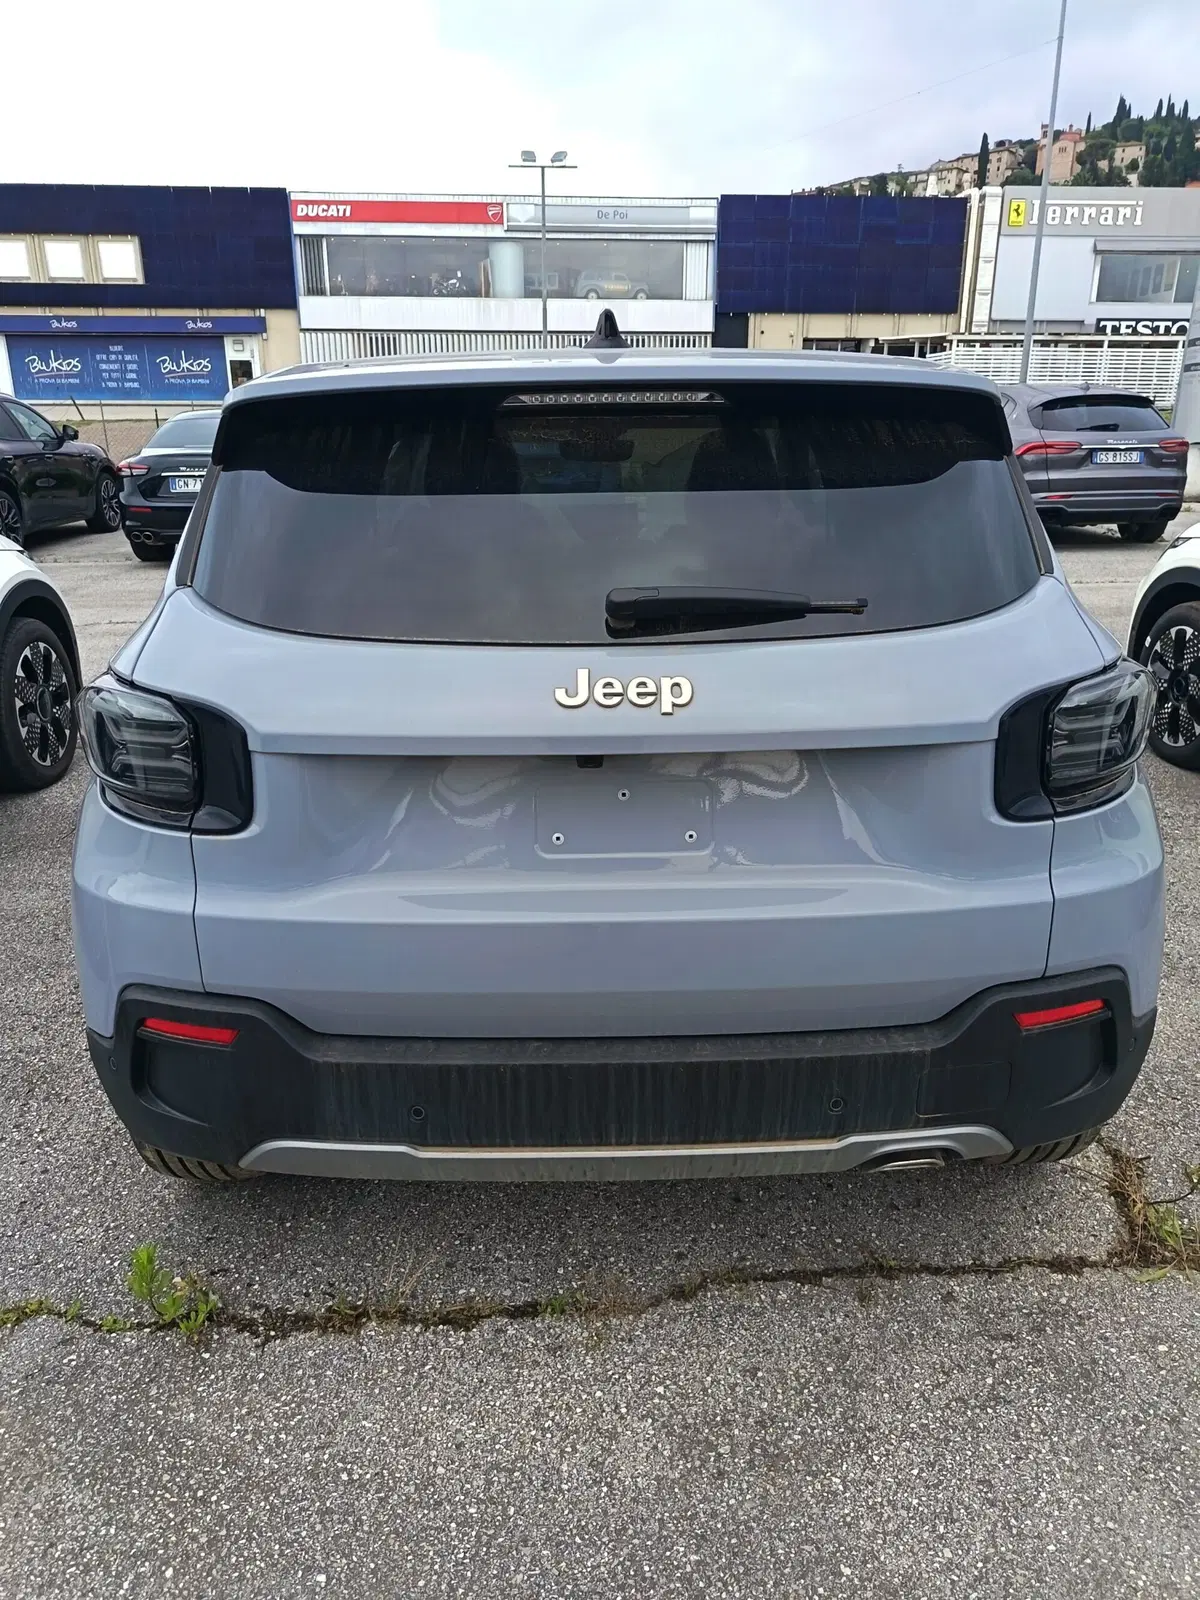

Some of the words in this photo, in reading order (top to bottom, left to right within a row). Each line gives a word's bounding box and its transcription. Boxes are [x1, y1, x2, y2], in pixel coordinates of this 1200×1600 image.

[296, 204, 351, 217] DUCATI
[597, 209, 610, 220] De
[613, 209, 628, 220] Poi
[1098, 452, 1109, 462] GS
[177, 479, 189, 489] GN
[554, 668, 694, 716] Jeep
